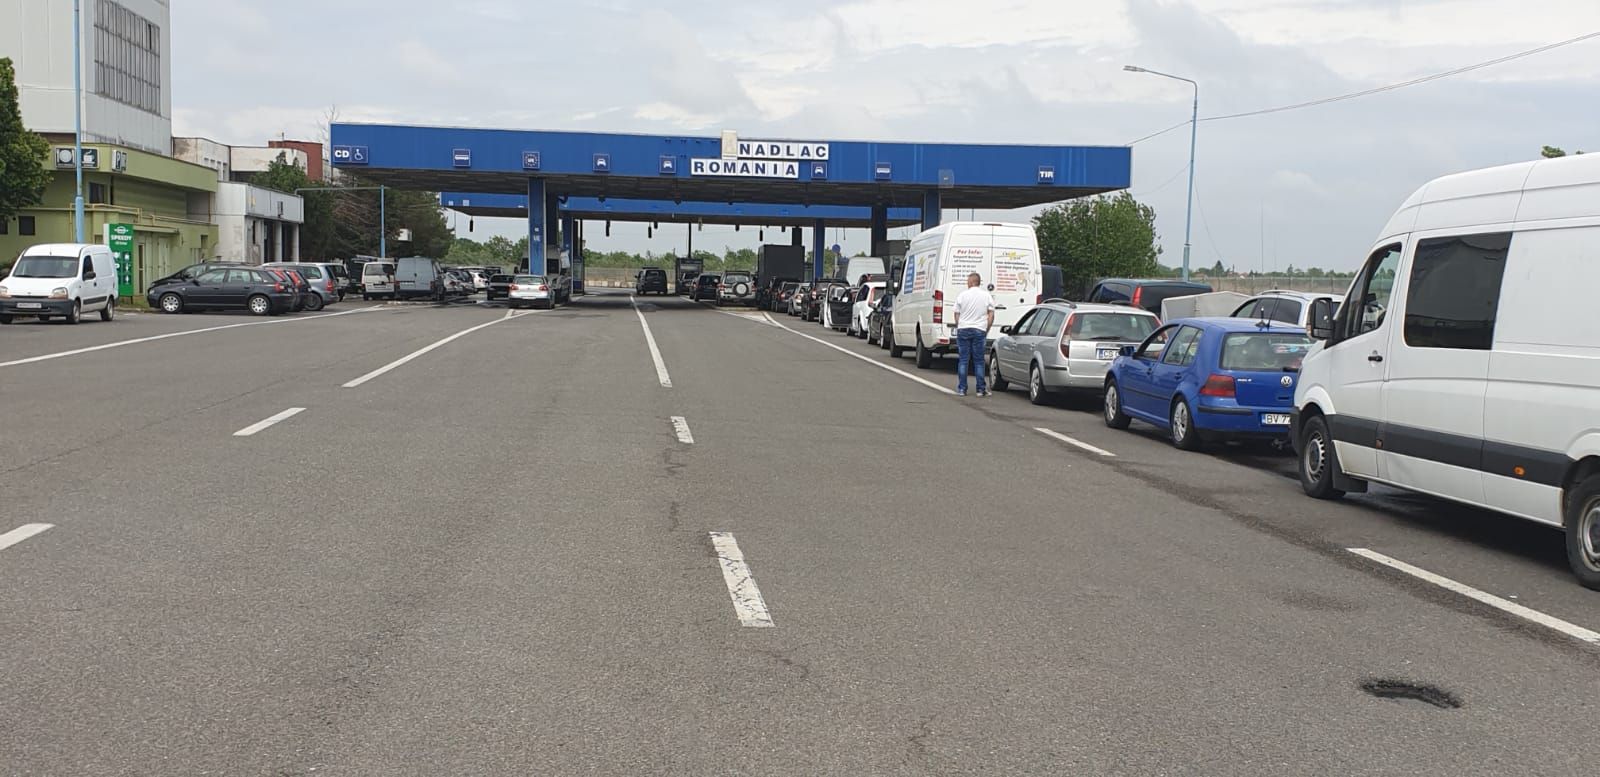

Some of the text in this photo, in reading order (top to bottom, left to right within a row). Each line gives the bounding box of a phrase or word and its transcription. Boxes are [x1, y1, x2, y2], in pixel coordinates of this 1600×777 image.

[334, 149, 350, 158] CD
[739, 143, 827, 158] NADLAC
[693, 161, 797, 176] ROMANIA
[1039, 170, 1055, 178] TIR
[1104, 350, 1114, 358] CS
[1267, 414, 1279, 424] BV
